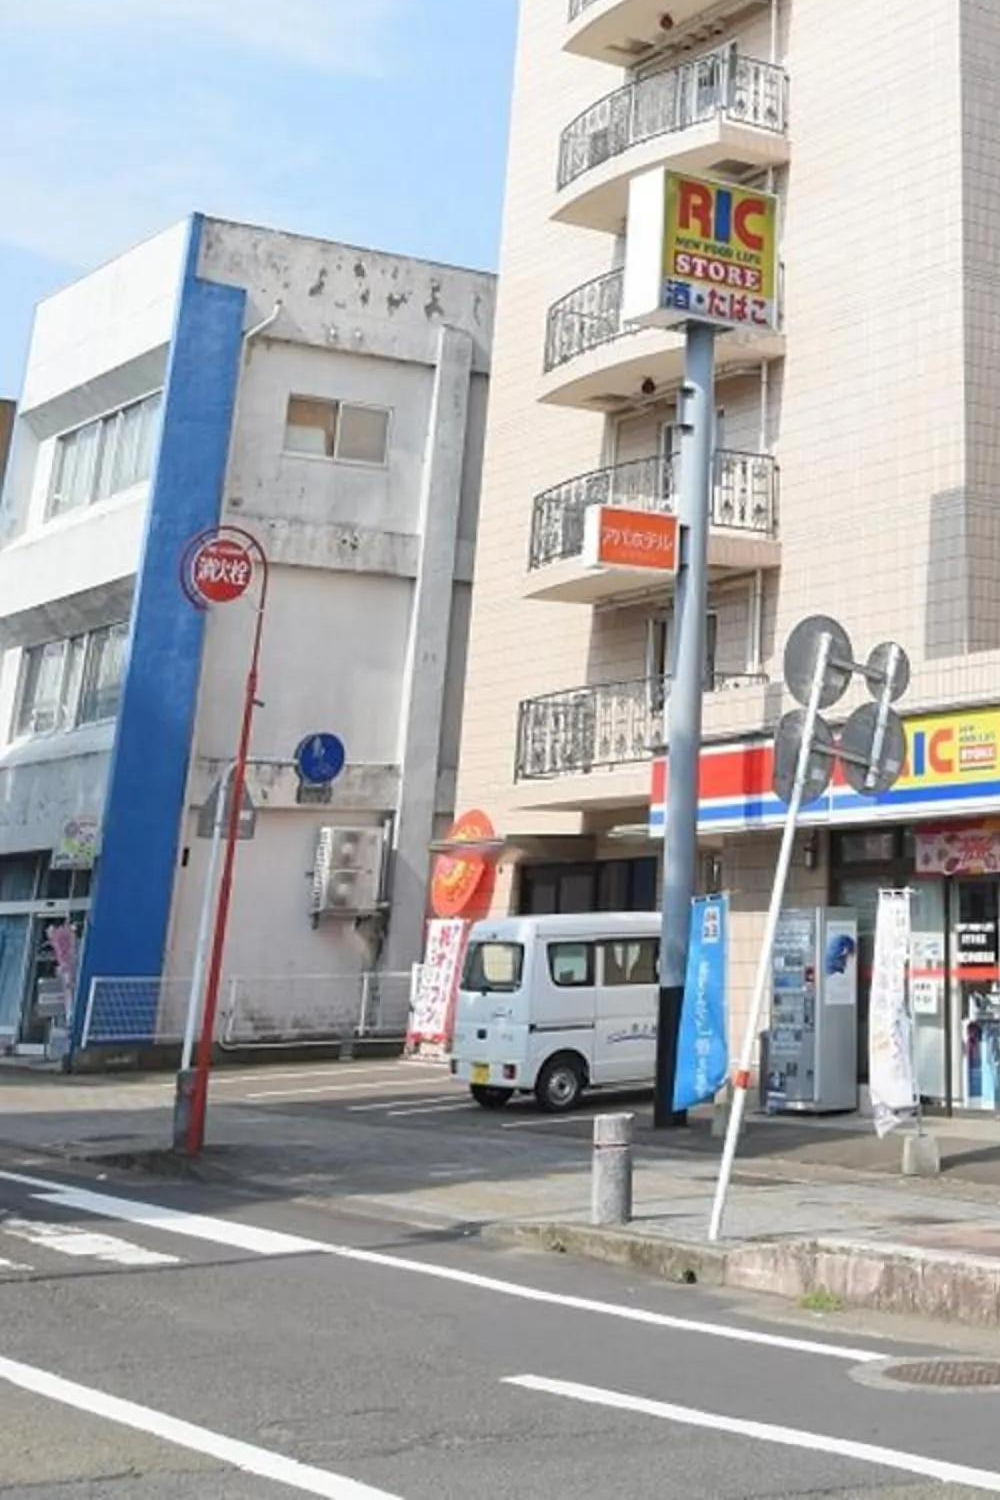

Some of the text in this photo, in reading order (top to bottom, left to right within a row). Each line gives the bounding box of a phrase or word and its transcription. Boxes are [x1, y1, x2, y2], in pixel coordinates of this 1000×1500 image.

[677, 179, 767, 252] RIC
[674, 252, 761, 290] STORE
[196, 557, 248, 586] 消火栓
